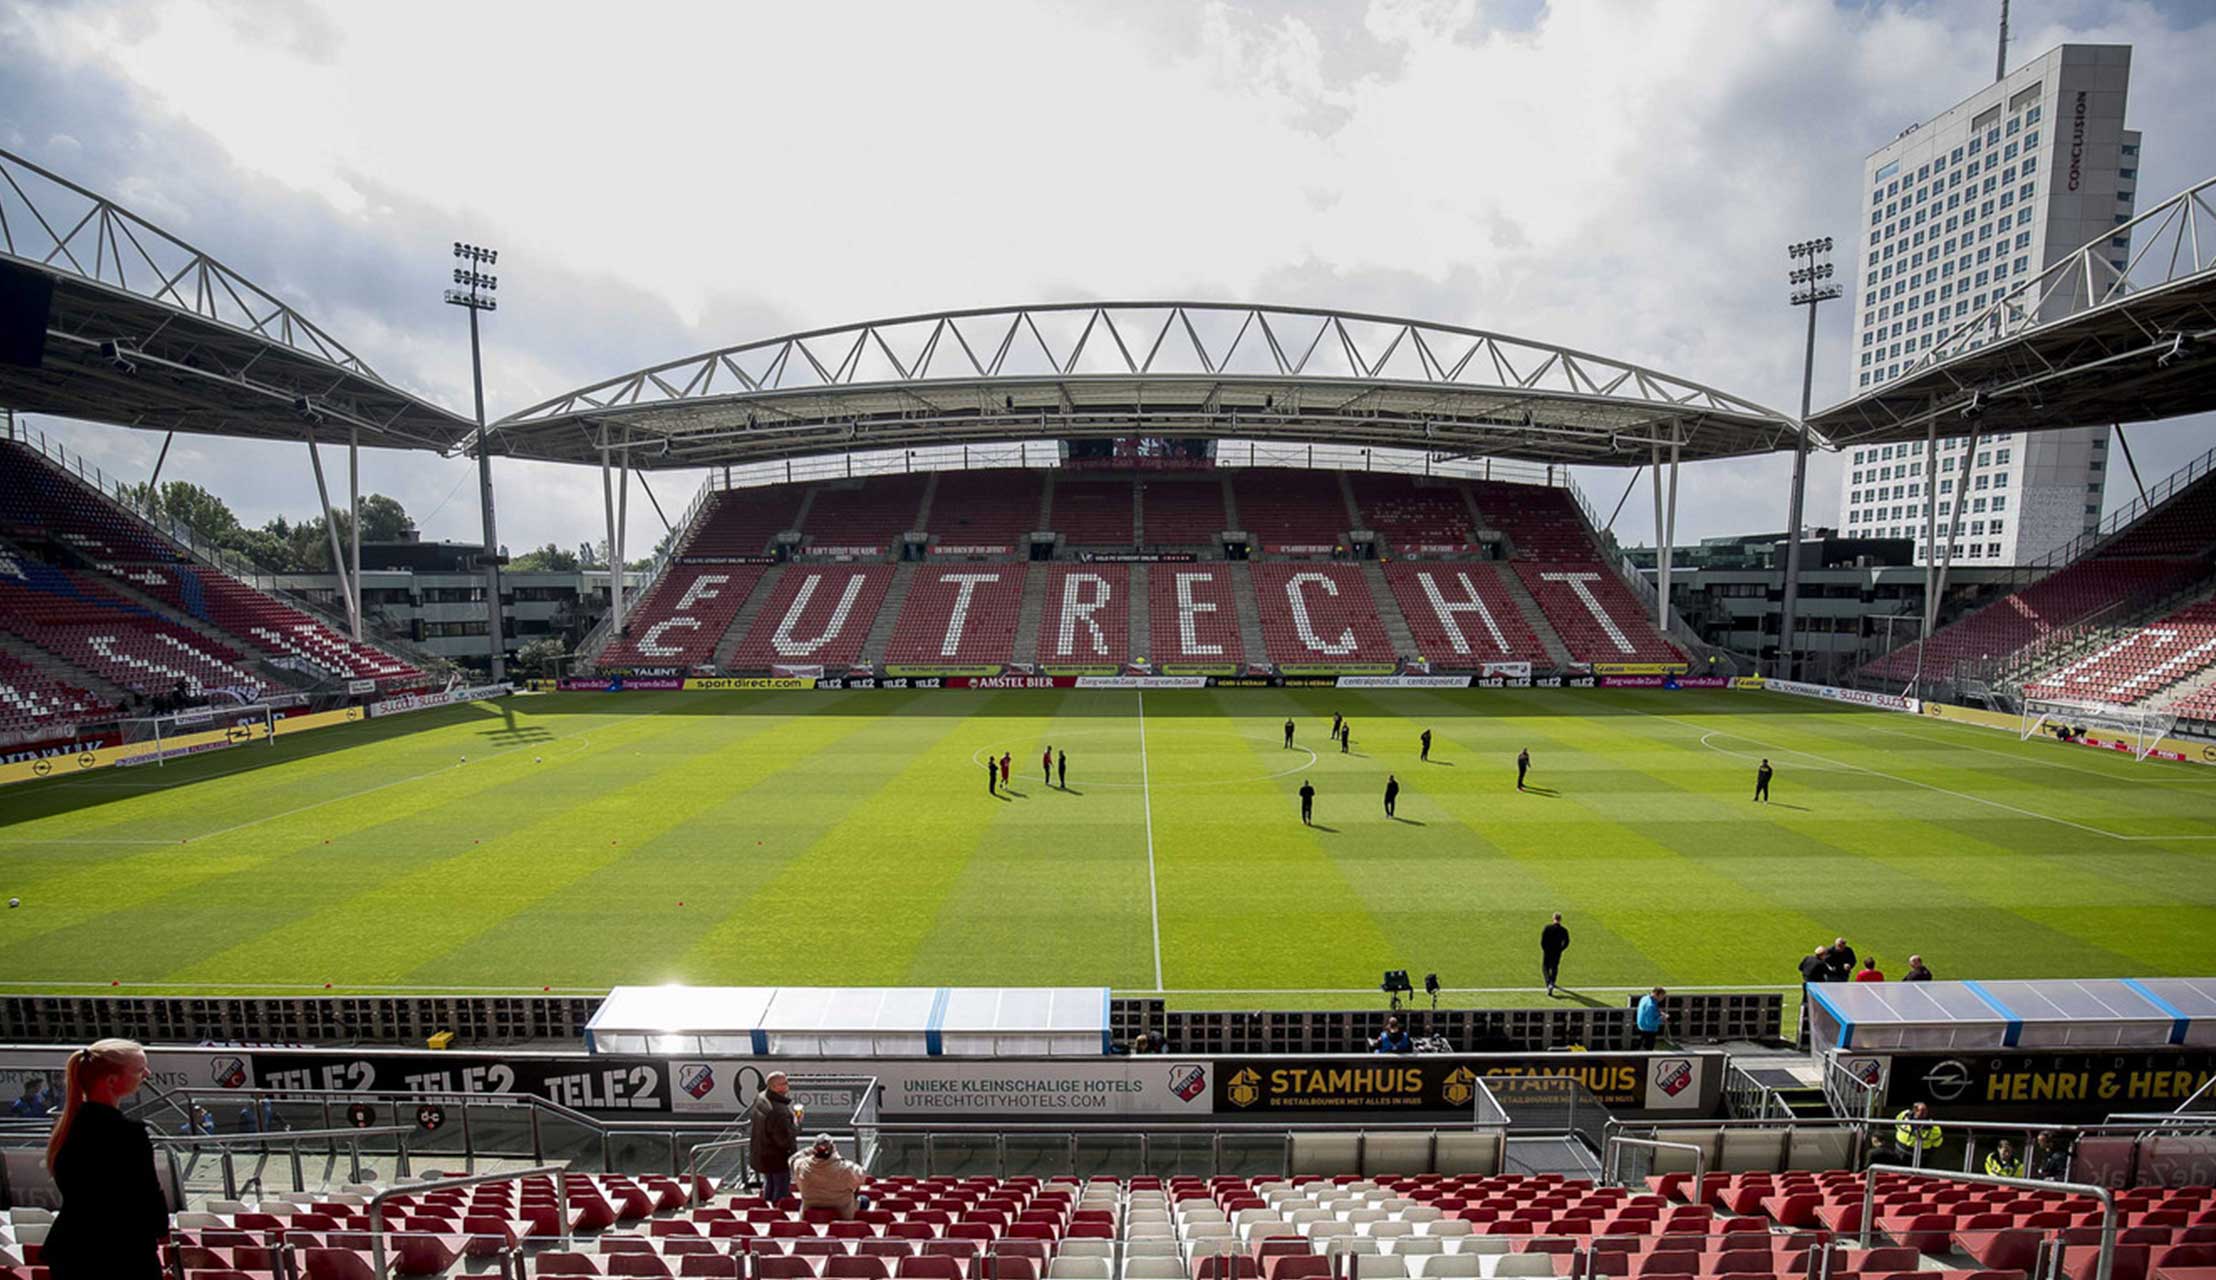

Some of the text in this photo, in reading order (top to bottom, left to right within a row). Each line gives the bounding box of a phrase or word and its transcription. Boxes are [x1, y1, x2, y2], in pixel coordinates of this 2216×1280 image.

[2068, 91, 2086, 191] CONCLUSION
[817, 678, 842, 689] TELE2
[850, 678, 875, 689] TELE2
[883, 678, 908, 689] TELE2
[915, 678, 940, 689] TELE2
[979, 677, 1053, 688] AMSTEL BIER
[1479, 677, 1503, 688] TELE2
[1506, 677, 1531, 688] TELE2
[1537, 677, 1561, 688] TELE2
[1570, 677, 1595, 688] TELE2
[266, 1061, 379, 1101] TELE2
[404, 1064, 517, 1104] TELE2
[1270, 1068, 1423, 1093] STAMHUIS
[1486, 1067, 1636, 1092] STAMHUIS
[544, 1065, 661, 1108] TELE2
[903, 1080, 1142, 1092] UNIEKE KLEINSCHALIGE HOTELS
[1987, 1072, 2090, 1100] HENRI
[2097, 1072, 2121, 1100] &
[904, 1095, 1106, 1107] UTRECHTCITYHOTELS.COM
[1283, 1097, 1345, 1105] RETAILBOUWER
[1365, 1097, 1390, 1105] ALLES
